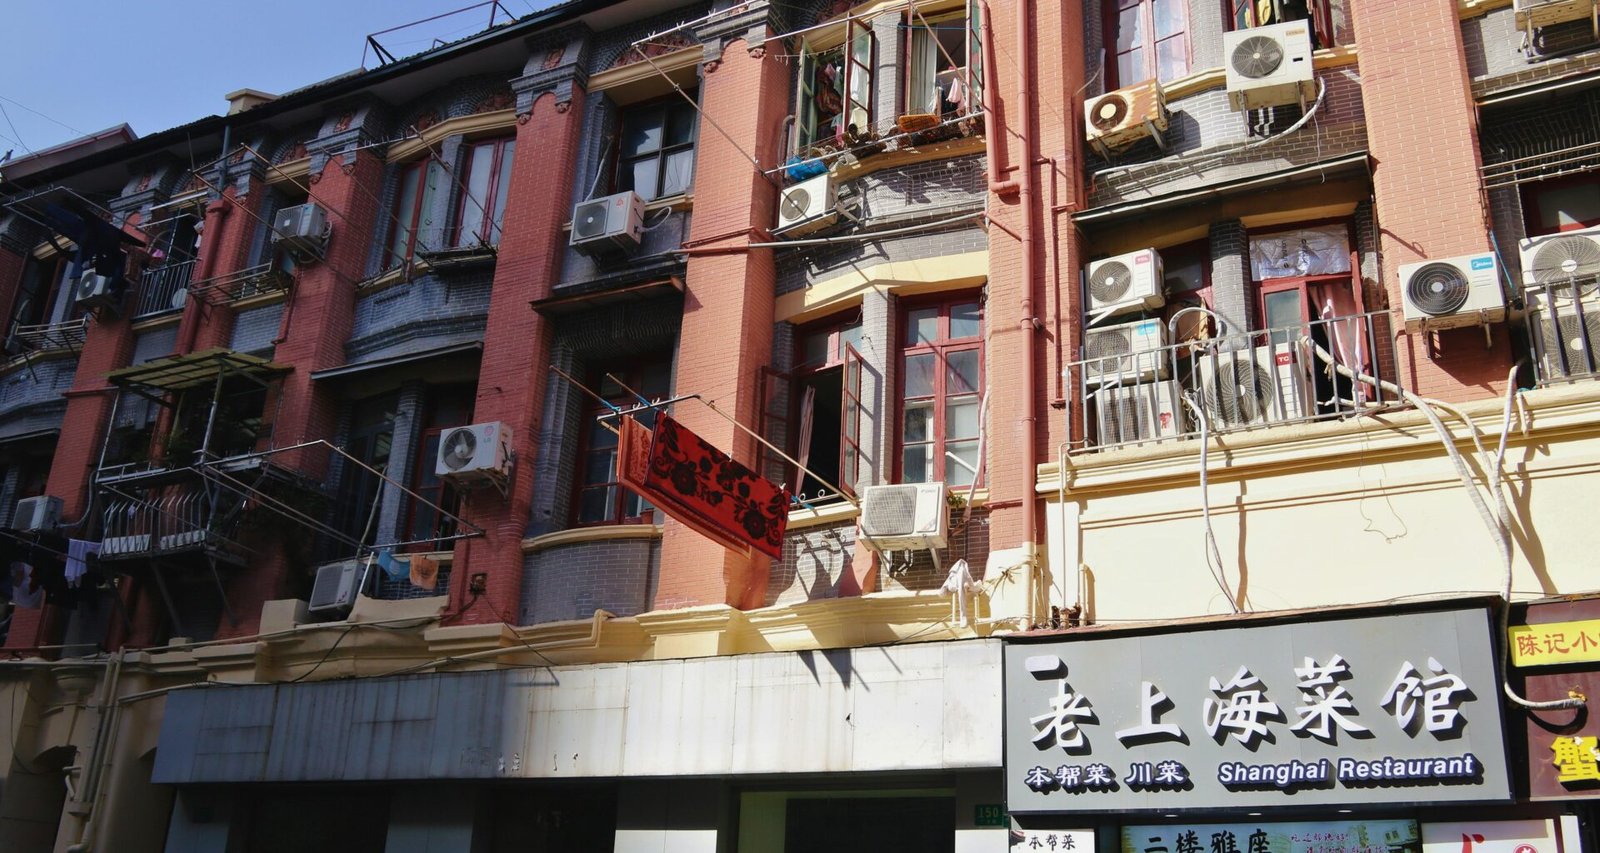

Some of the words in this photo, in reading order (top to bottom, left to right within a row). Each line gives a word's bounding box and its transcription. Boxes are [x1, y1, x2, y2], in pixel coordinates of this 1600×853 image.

[1516, 630, 1600, 657] 陈记小
[1029, 653, 1468, 748] 老上海菜馆
[1025, 762, 1113, 786] 本帮菜
[1126, 761, 1185, 783] 川菜
[1219, 759, 1327, 783] Shanghai
[1338, 756, 1473, 778] Restaurant
[978, 807, 999, 818] 150
[1028, 833, 1076, 851] 本帮菜
[1144, 828, 1272, 853] 二楼雅座
